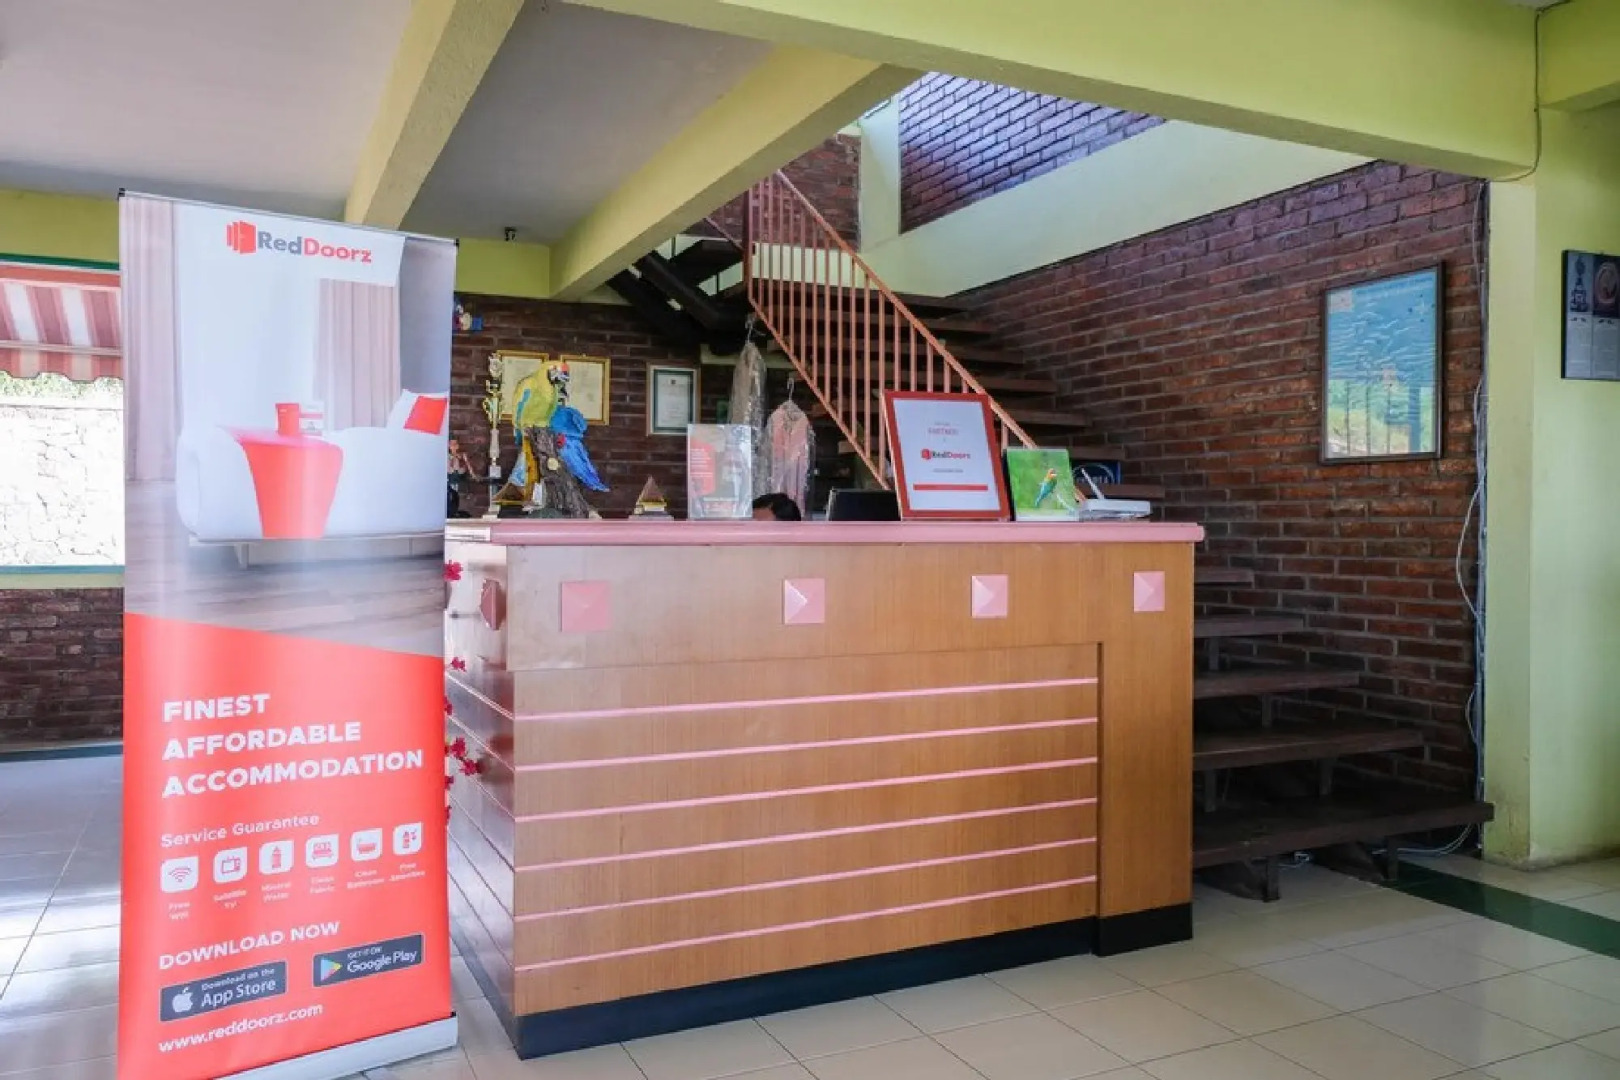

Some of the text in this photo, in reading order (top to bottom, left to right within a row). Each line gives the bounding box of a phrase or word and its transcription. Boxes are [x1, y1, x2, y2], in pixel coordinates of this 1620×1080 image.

[258, 231, 372, 264] RedDoorz
[163, 693, 270, 722] FINEST
[162, 721, 361, 760] AFFORDABLE
[162, 749, 422, 798] ACCOMMODATION
[161, 815, 319, 848] Service Guarantee
[159, 921, 340, 970] DOWNLOAD NOW
[347, 950, 418, 973] Google Play
[201, 979, 276, 1007] App Store
[202, 973, 246, 991] Download
[261, 968, 274, 977] the
[159, 1003, 323, 1052] www.reddoorz.com
